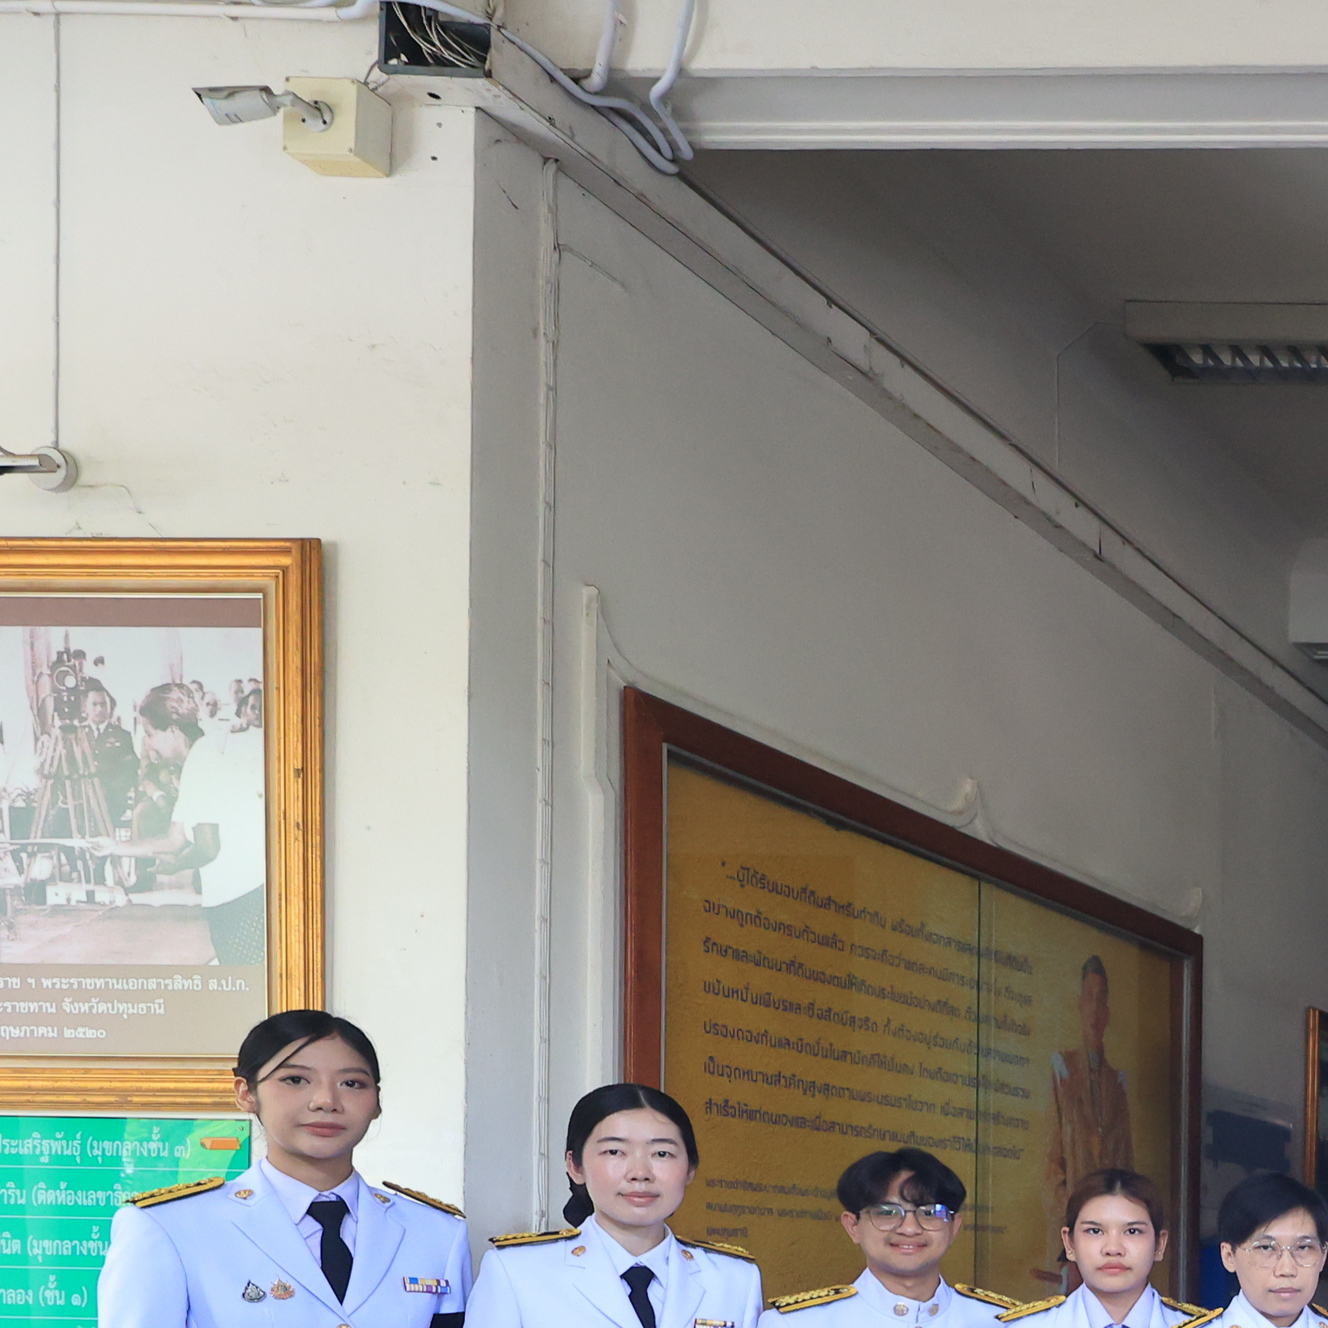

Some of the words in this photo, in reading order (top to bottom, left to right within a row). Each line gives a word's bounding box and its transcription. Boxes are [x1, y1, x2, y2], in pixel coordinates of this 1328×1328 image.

[41, 973, 202, 991] พระราชทานเอกสารสิทธิ
[207, 975, 250, 991] ส.ป.ก.
[61, 996, 165, 1019] จังหวัดปทุมธานี
[86, 1126, 170, 1165] (มุขกลางชั้น
